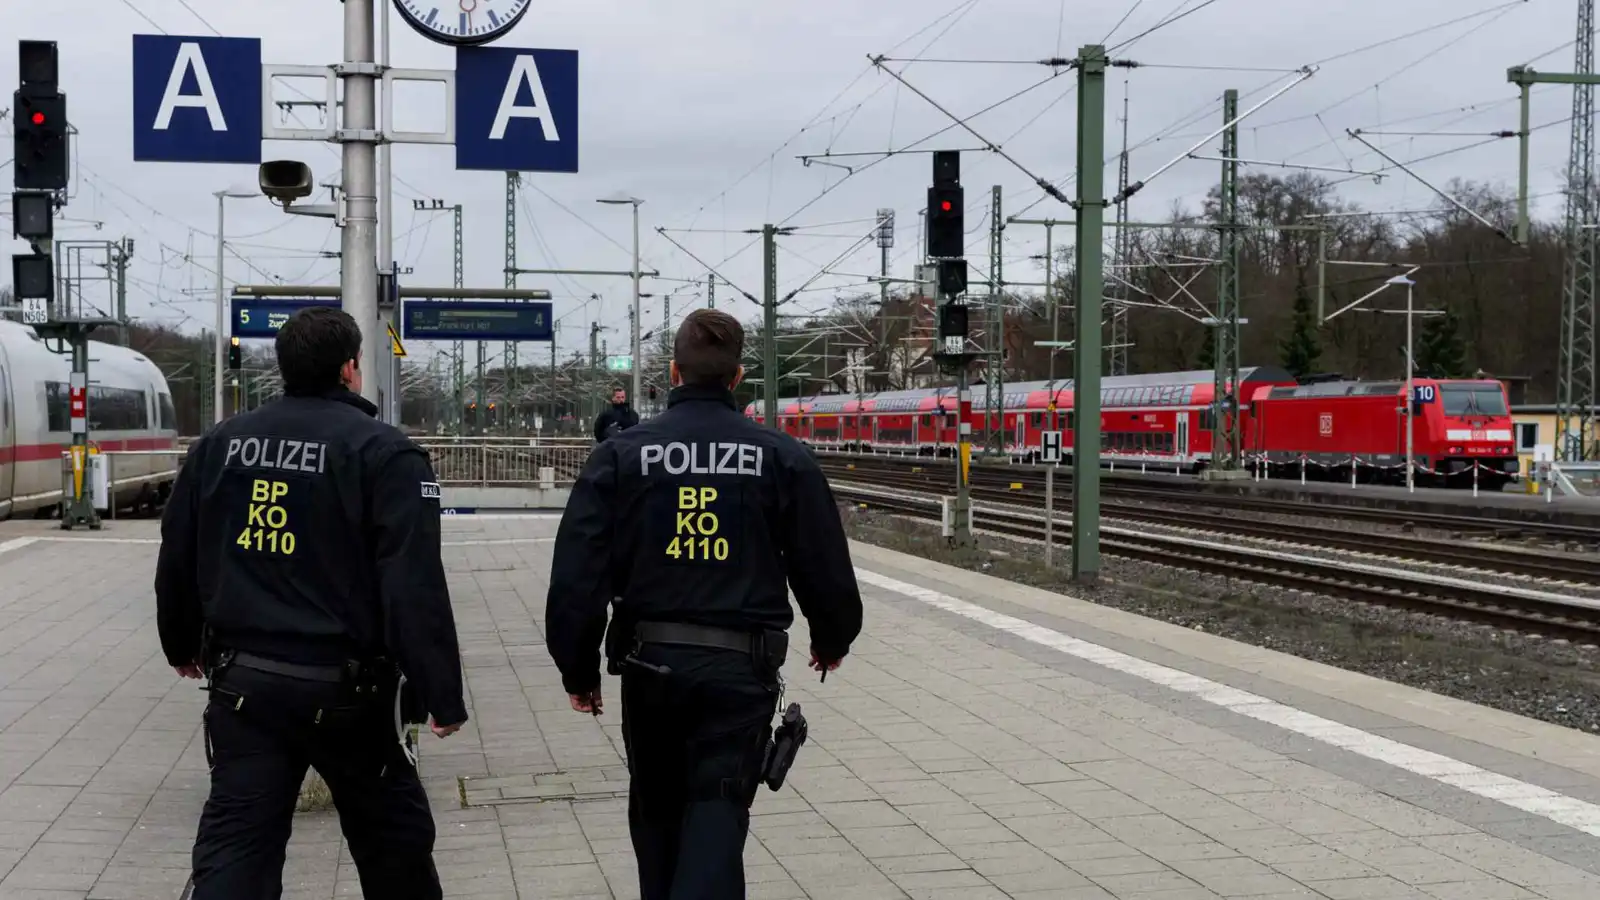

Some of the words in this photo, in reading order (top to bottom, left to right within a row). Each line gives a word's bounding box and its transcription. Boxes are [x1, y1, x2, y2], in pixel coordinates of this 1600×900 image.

[152, 42, 228, 131] A
[488, 54, 560, 142] A
[240, 309, 250, 324] 5
[535, 312, 543, 327] 4
[1418, 386, 1434, 400] 10
[225, 437, 327, 473] POLIZEI
[1043, 432, 1060, 459] H
[640, 441, 763, 476] POLIZEI
[252, 479, 288, 503] BP
[678, 486, 718, 510] BP
[248, 503, 287, 528] KO
[676, 512, 719, 535] KO
[237, 528, 296, 555] 4110
[665, 537, 729, 561] 4110
